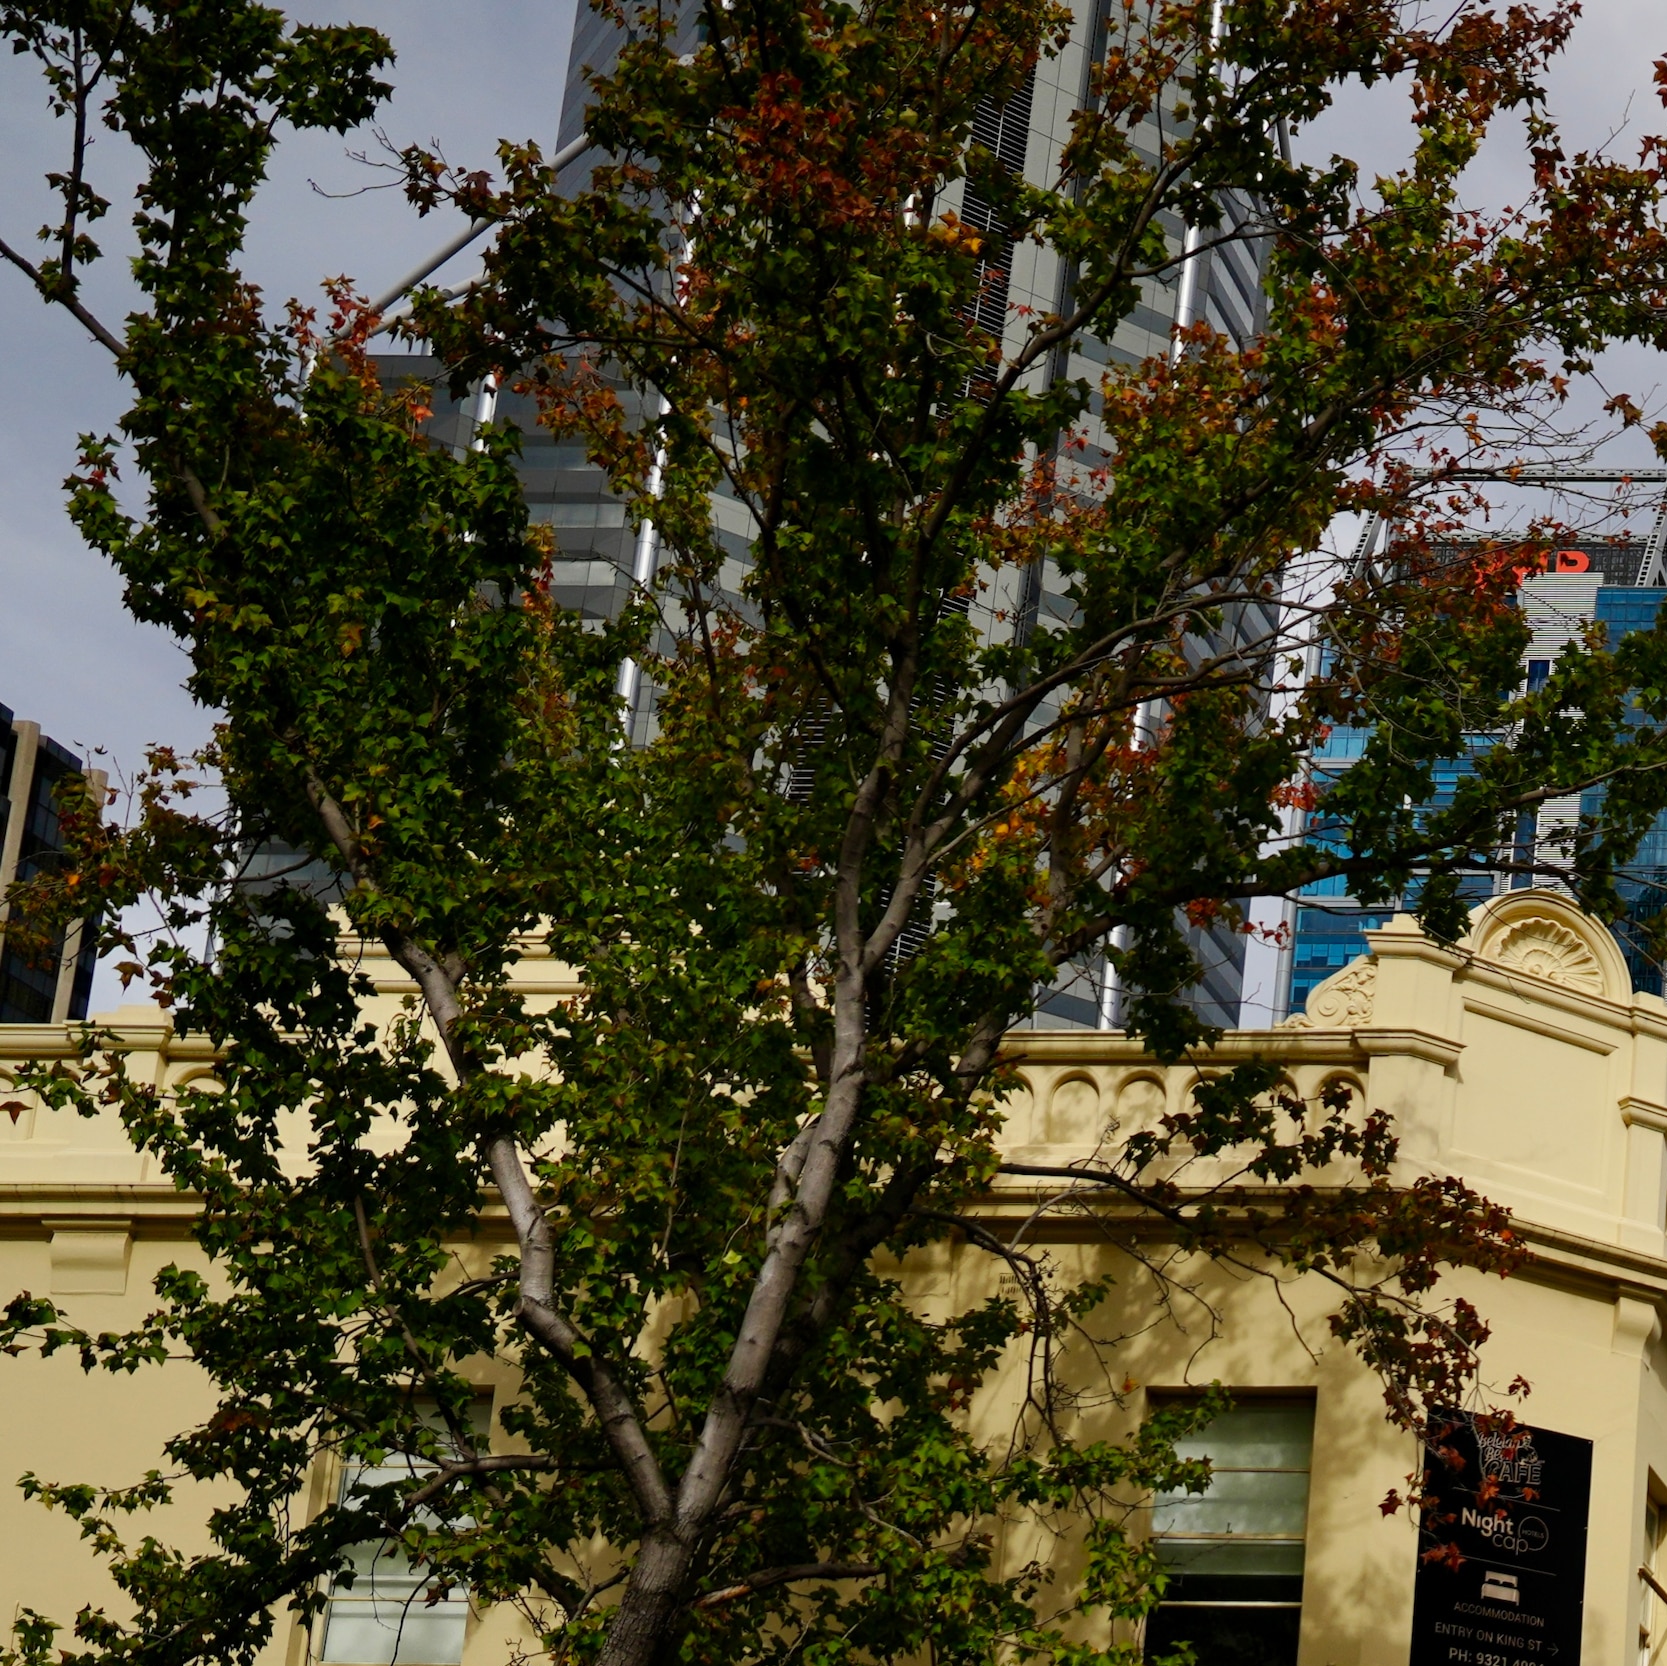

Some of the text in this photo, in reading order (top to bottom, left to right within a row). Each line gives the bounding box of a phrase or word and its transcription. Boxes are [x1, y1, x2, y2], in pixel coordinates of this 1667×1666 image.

[1462, 1506, 1514, 1537] Night
[1492, 1534, 1528, 1556] cap
[1454, 1601, 1545, 1628] ACCOMMODATION
[1434, 1621, 1543, 1652] ENTRY ON KING ST
[1448, 1647, 1473, 1663] PH:
